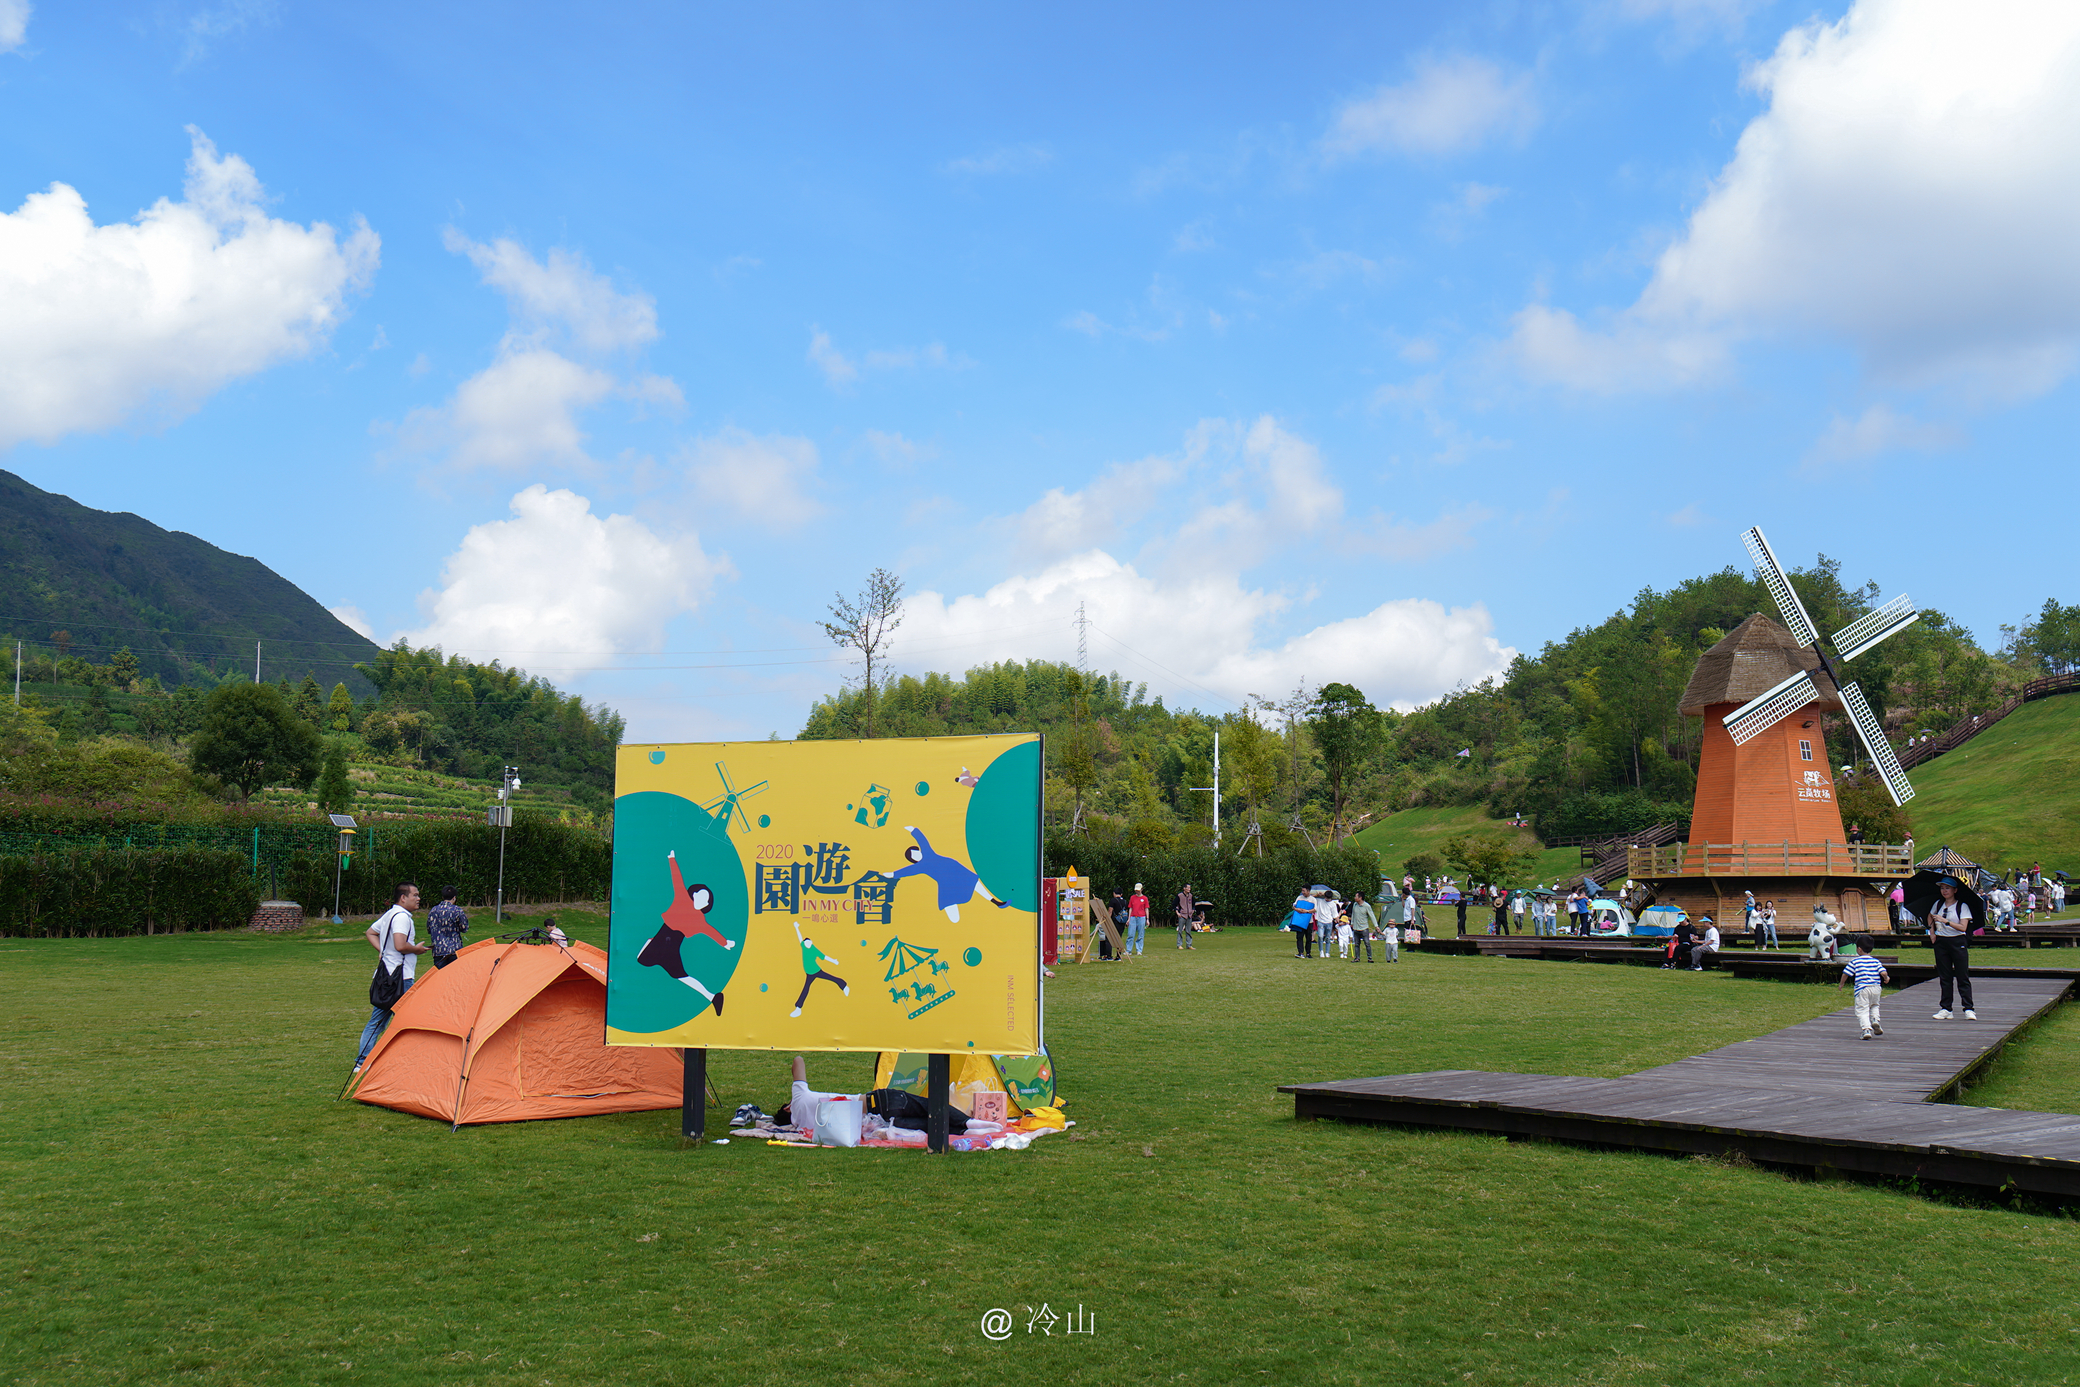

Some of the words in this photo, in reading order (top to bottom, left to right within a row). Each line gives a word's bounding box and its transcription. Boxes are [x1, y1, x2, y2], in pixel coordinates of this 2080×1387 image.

[756, 844, 794, 860] 2020
[755, 842, 900, 925] 園遊會
[802, 899, 817, 912] IN
[820, 899, 841, 912] MY
[841, 898, 875, 913] CITY
[1007, 974, 1015, 990] INM
[1007, 992, 1015, 1032] SELECTED
